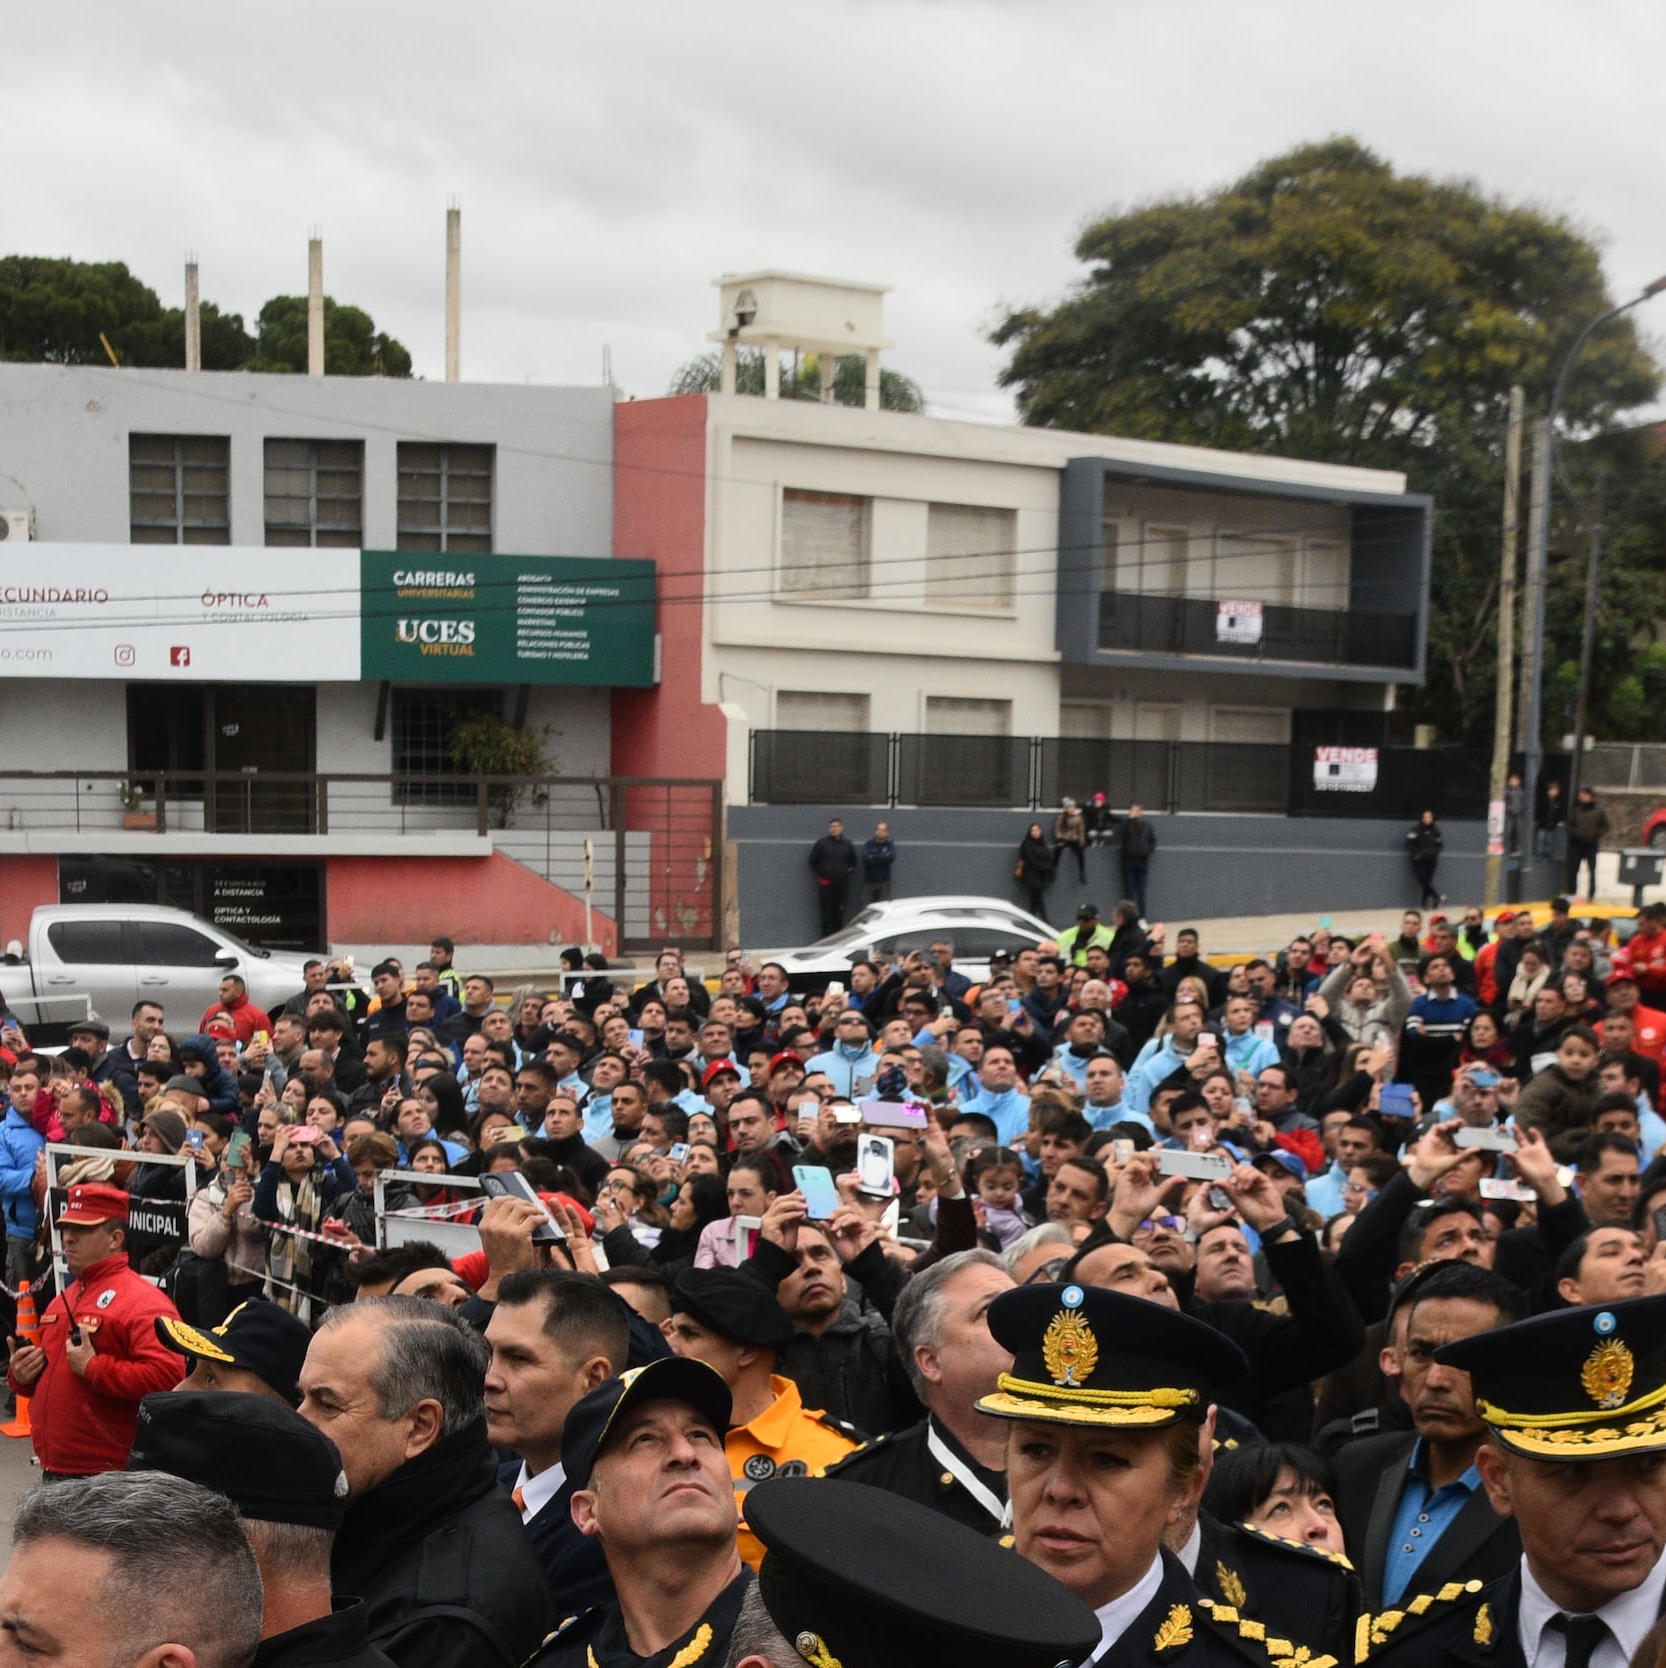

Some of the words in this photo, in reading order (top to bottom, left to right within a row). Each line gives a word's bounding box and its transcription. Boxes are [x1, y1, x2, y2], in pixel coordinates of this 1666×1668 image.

[393, 571, 476, 587] CARRERAS
[200, 588, 270, 609] ÓPTICA
[397, 588, 475, 600] UNIVERSITARIAS
[396, 620, 476, 645] UCES
[420, 643, 476, 657] VIRTUAL
[1316, 747, 1378, 763] VENDE
[222, 888, 264, 897] DISTANCIA
[244, 906, 251, 915] Y
